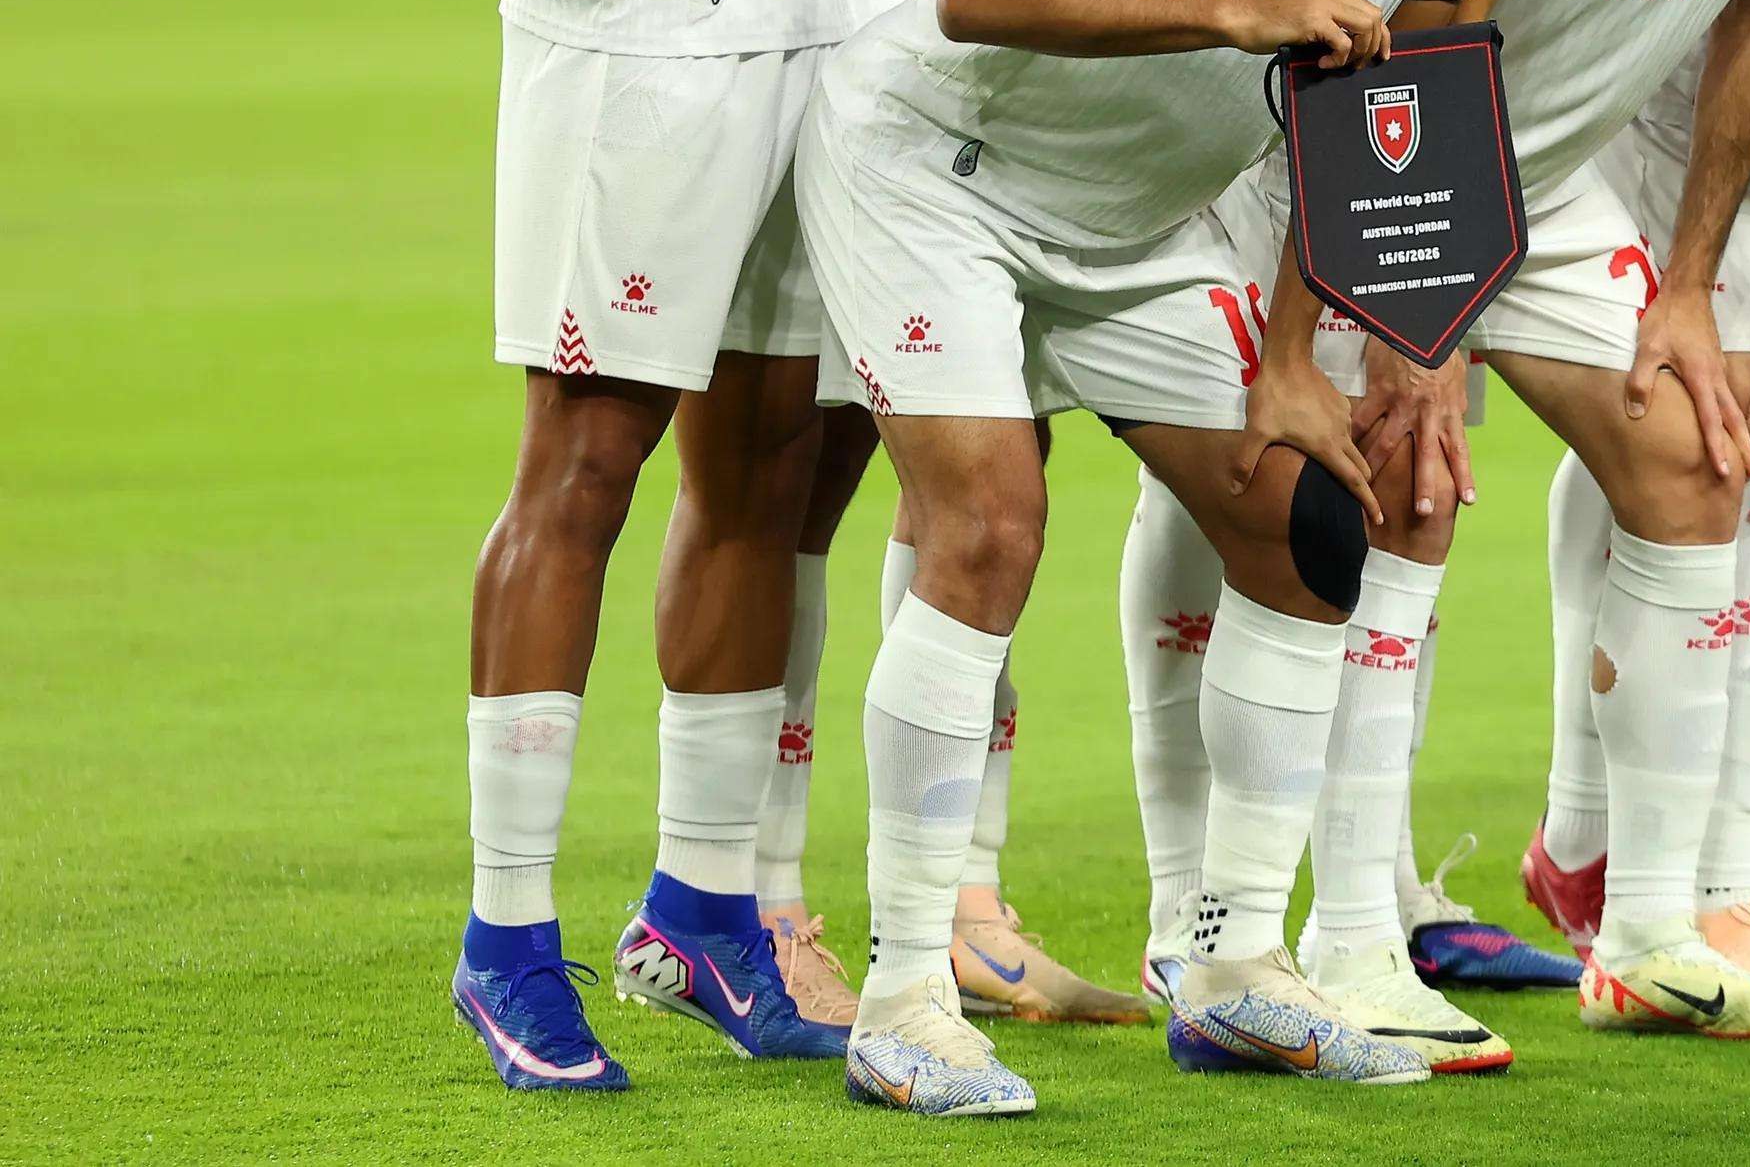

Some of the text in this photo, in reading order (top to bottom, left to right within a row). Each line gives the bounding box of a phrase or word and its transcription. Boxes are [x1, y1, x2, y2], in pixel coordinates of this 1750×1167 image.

[1372, 90, 1410, 104] JORDAN
[1350, 199, 1373, 212] FIFA
[1373, 196, 1403, 210] World
[1403, 194, 1423, 207] Cup
[1362, 219, 1451, 240] AUSTRIA vs JORDAN
[1378, 247, 1440, 266] 16/6/2026
[1352, 273, 1476, 296] SAN FRANCISCO BAY AREA STADIUM
[610, 300, 659, 316] KELME
[894, 342, 944, 354] KELME
[1156, 638, 1205, 656] KEL
[1686, 639, 1732, 650] KEL
